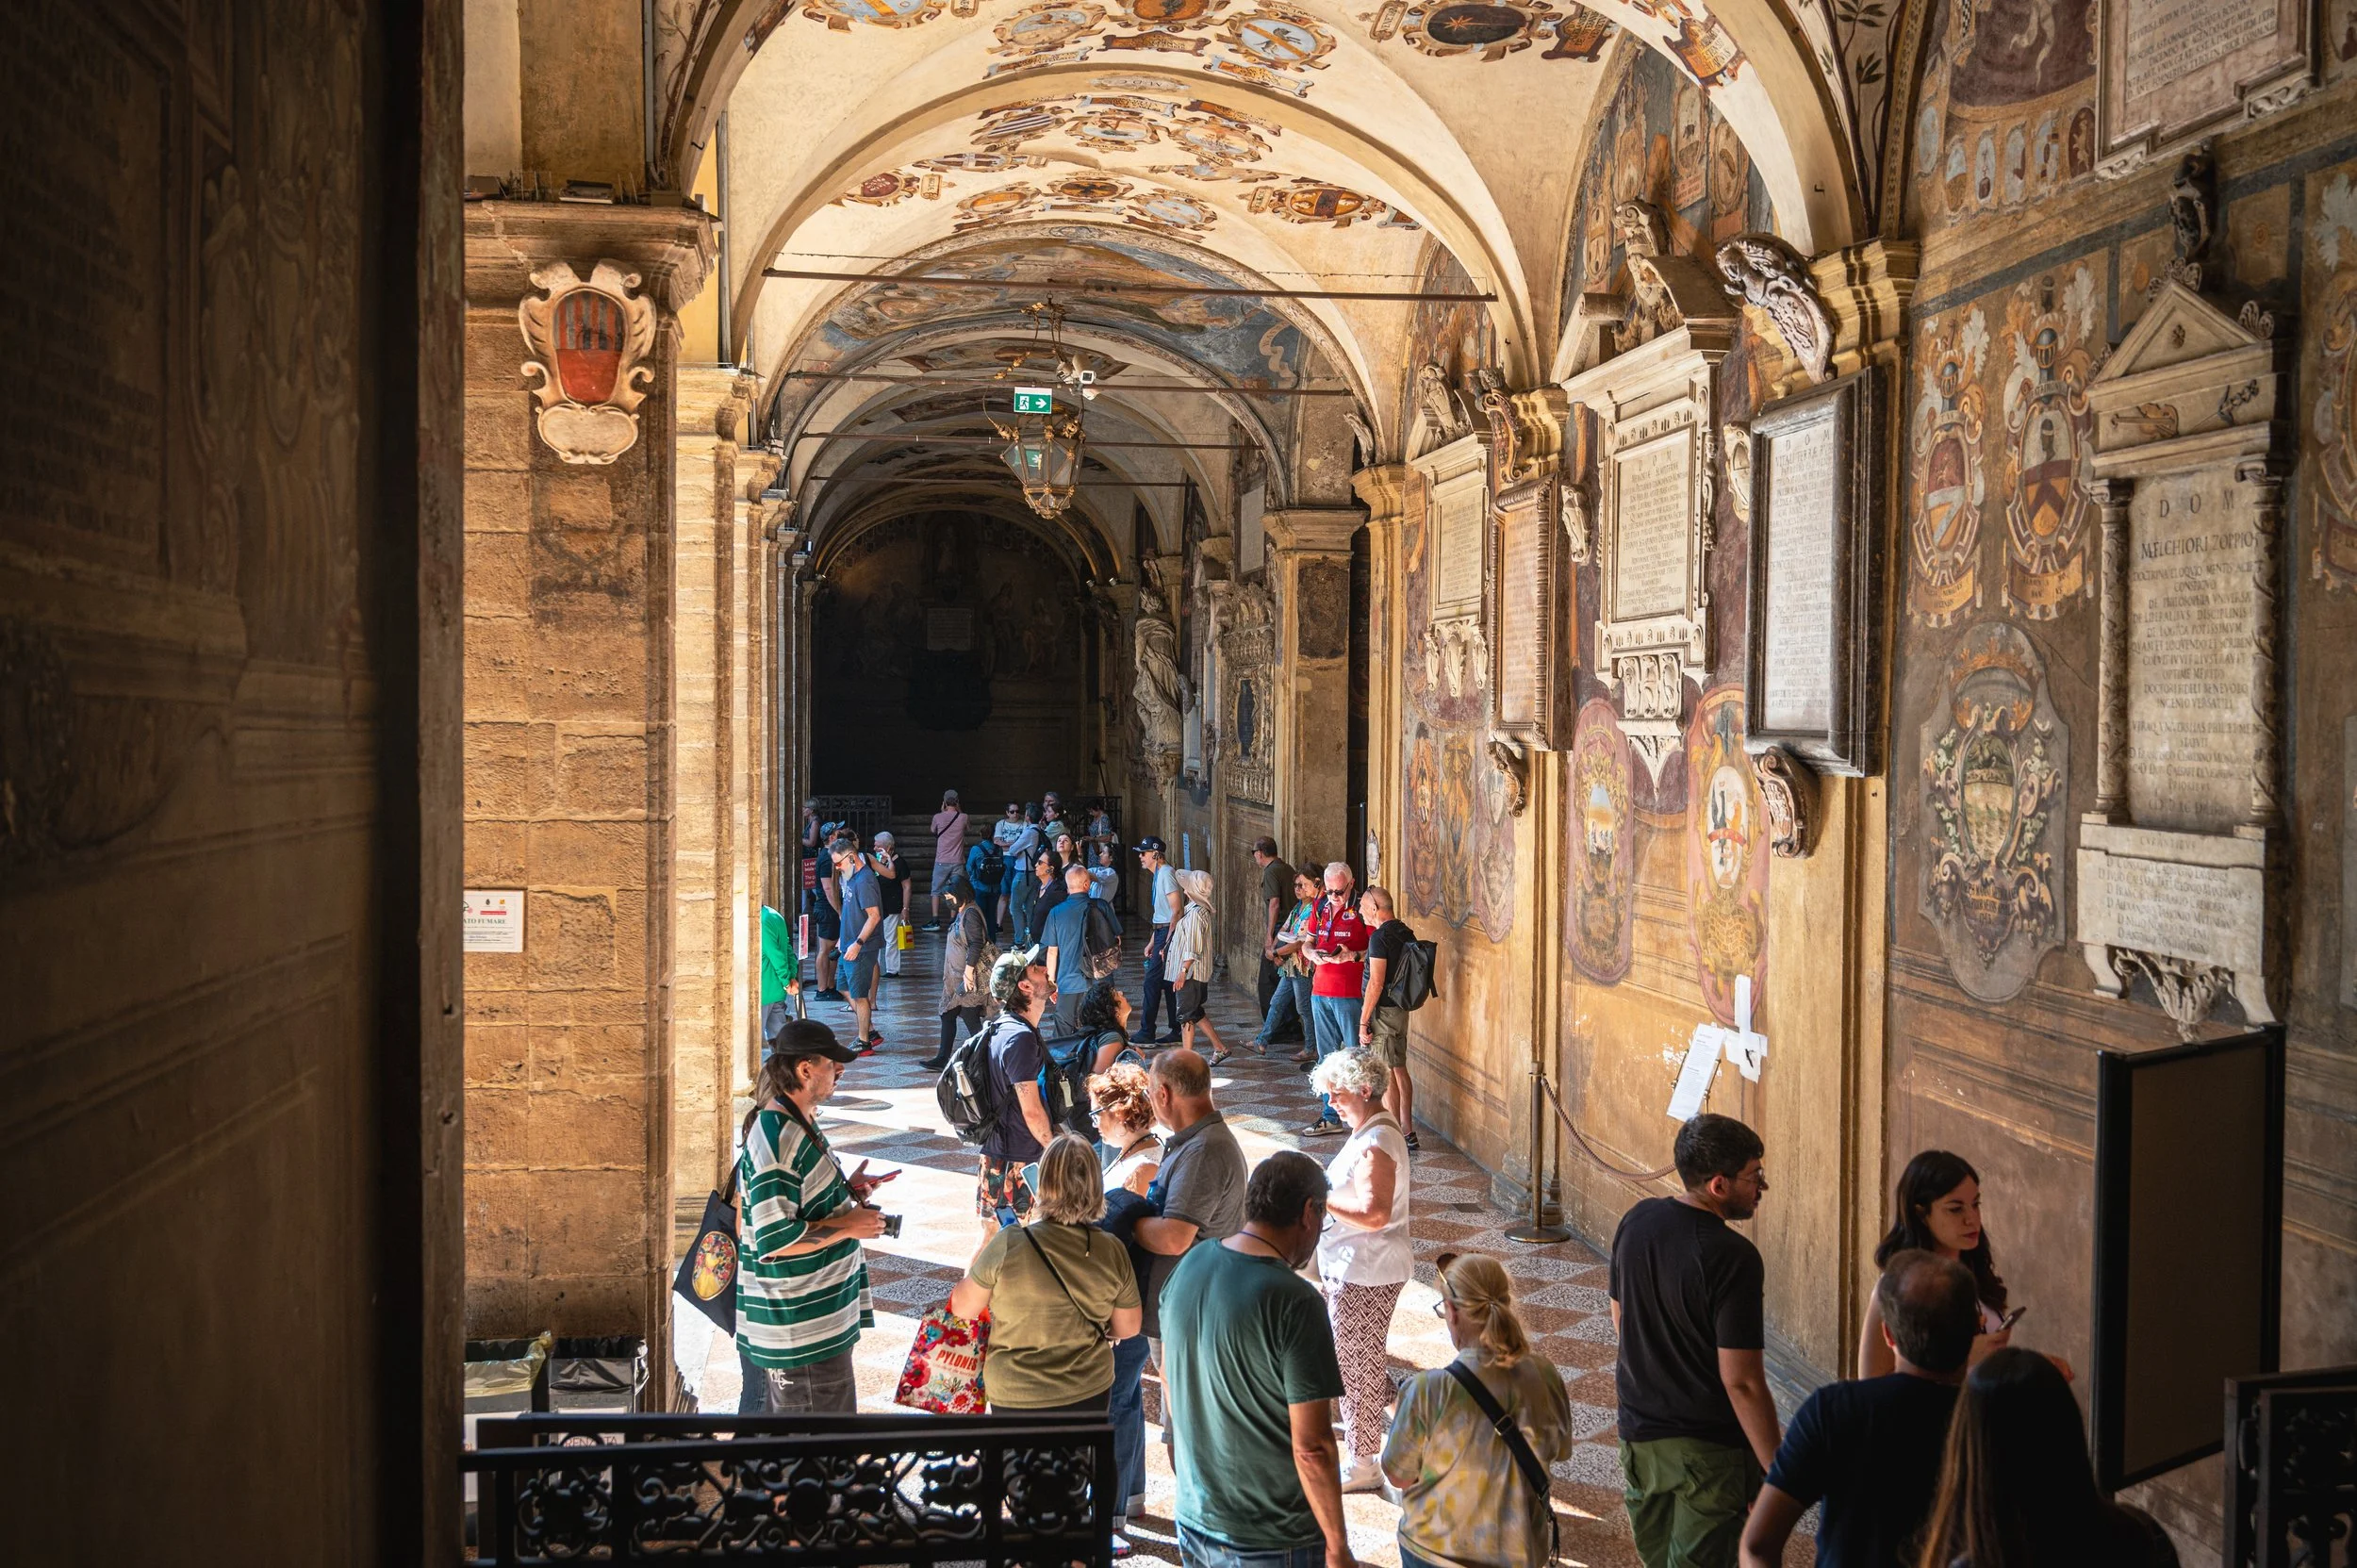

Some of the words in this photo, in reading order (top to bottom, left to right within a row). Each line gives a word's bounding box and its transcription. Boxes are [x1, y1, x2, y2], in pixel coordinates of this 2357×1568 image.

[1805, 433, 1811, 446] O
[2159, 498, 2170, 519] D
[2189, 492, 2201, 515] O
[2222, 487, 2234, 510] M
[2141, 535, 2208, 560] MELCHIORI
[2148, 598, 2158, 609] DE
[935, 1348, 979, 1372] PYLONES
